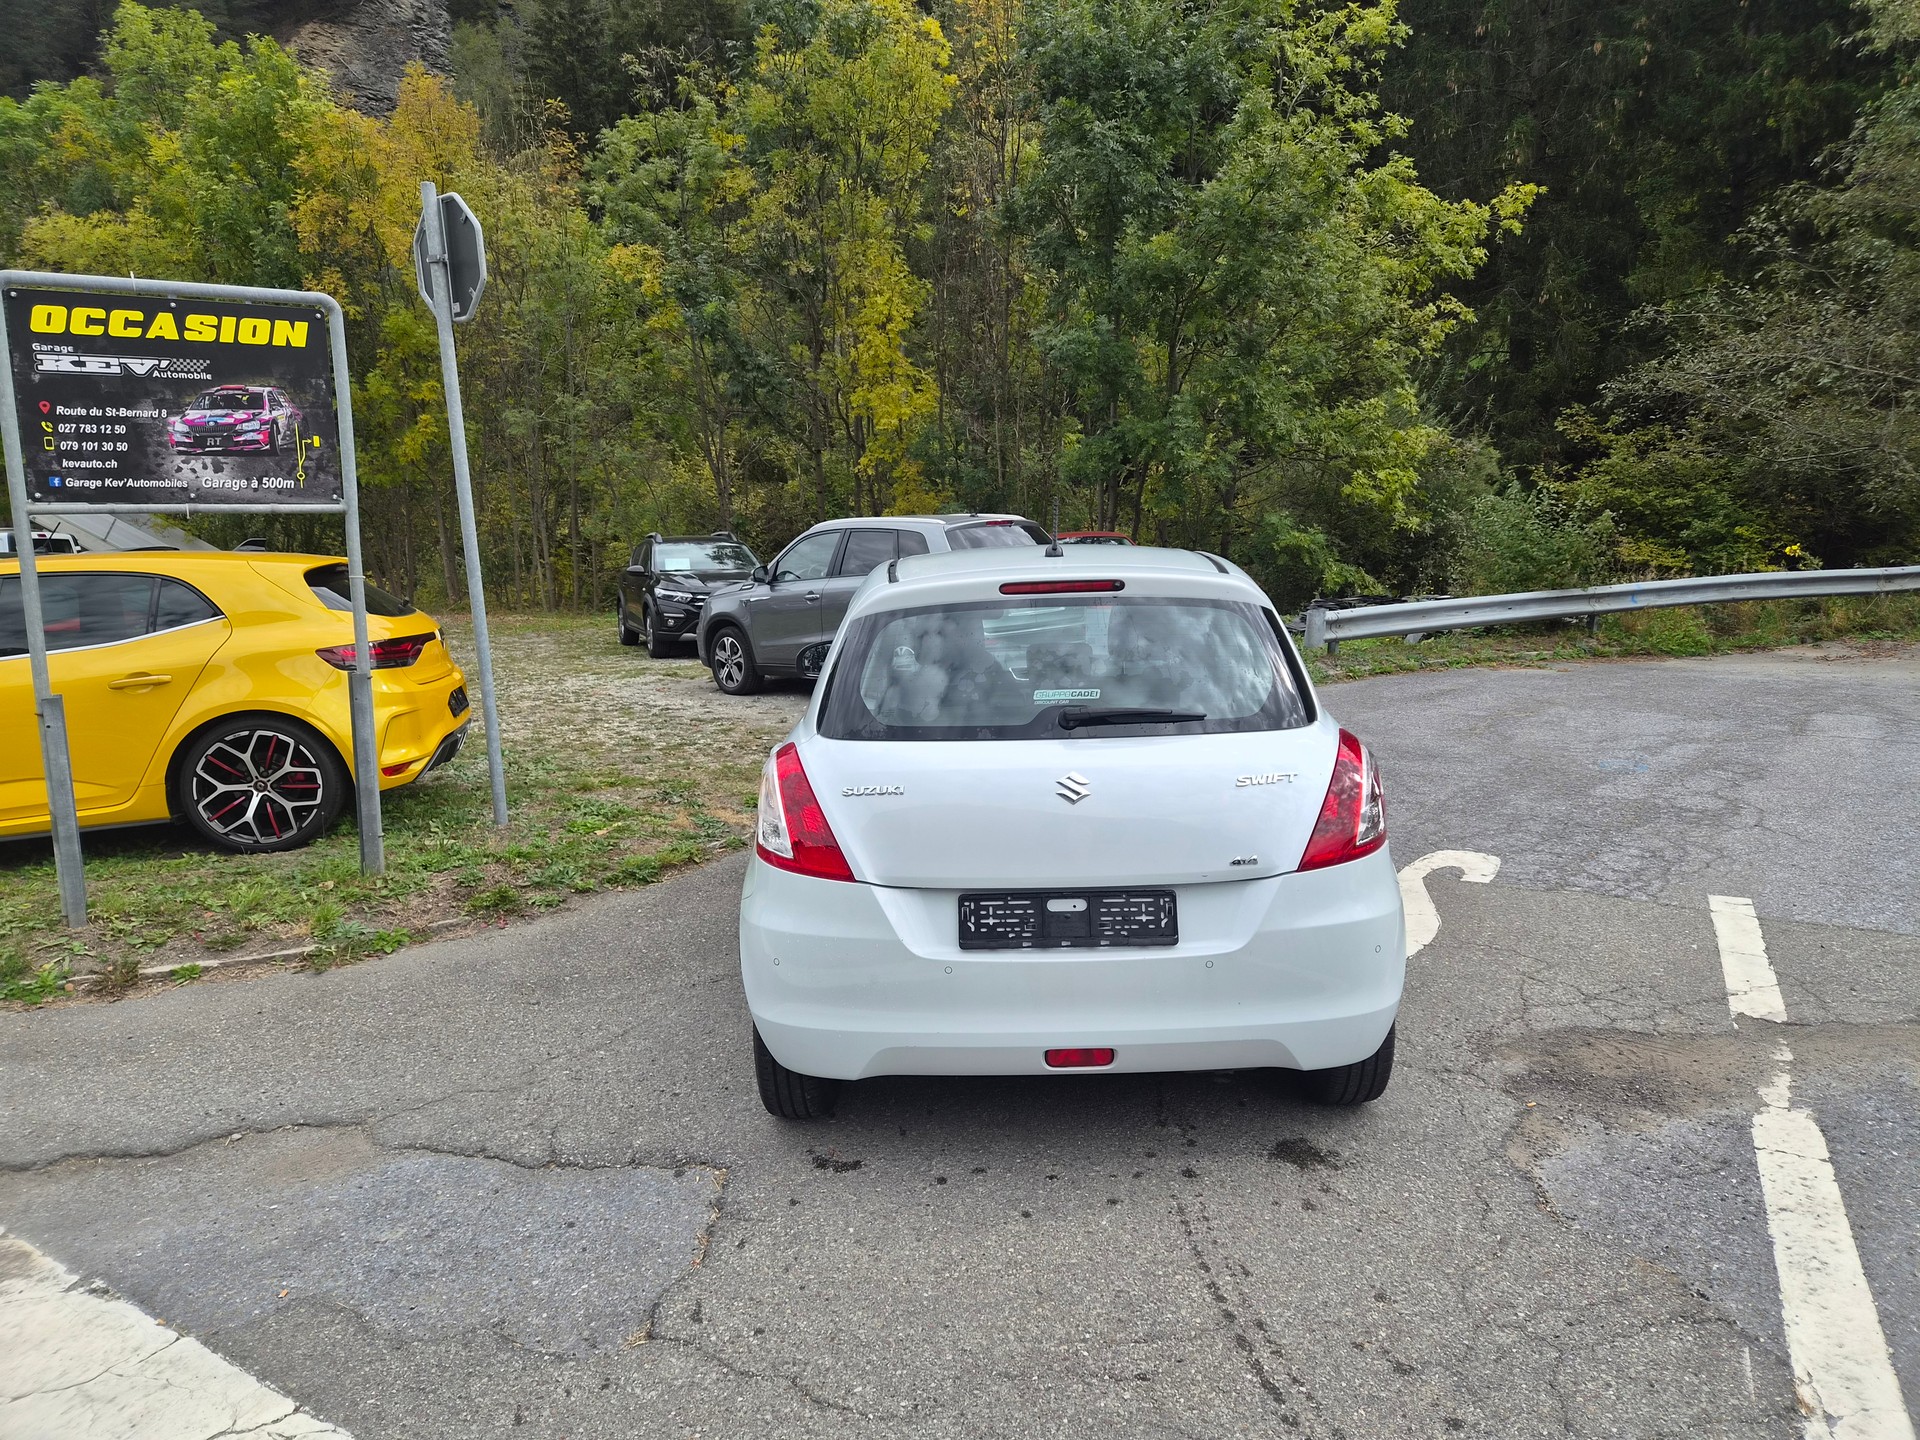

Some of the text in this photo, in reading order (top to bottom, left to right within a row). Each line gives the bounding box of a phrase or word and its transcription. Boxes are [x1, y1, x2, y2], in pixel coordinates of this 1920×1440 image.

[30, 304, 309, 347] OCCASION
[31, 342, 74, 353] Garage
[152, 370, 212, 380] Automobile
[56, 405, 167, 418] Route du St-Bernard 8
[58, 423, 127, 435] 027 783 12 50
[60, 441, 128, 452] 079 101 30 50
[206, 437, 222, 446] RT
[62, 458, 118, 469] kevauto.ch
[65, 478, 102, 490] Garage
[202, 476, 295, 490] Garage à 500m
[1235, 773, 1298, 788] SWIFT
[842, 785, 905, 797] SUZUKI
